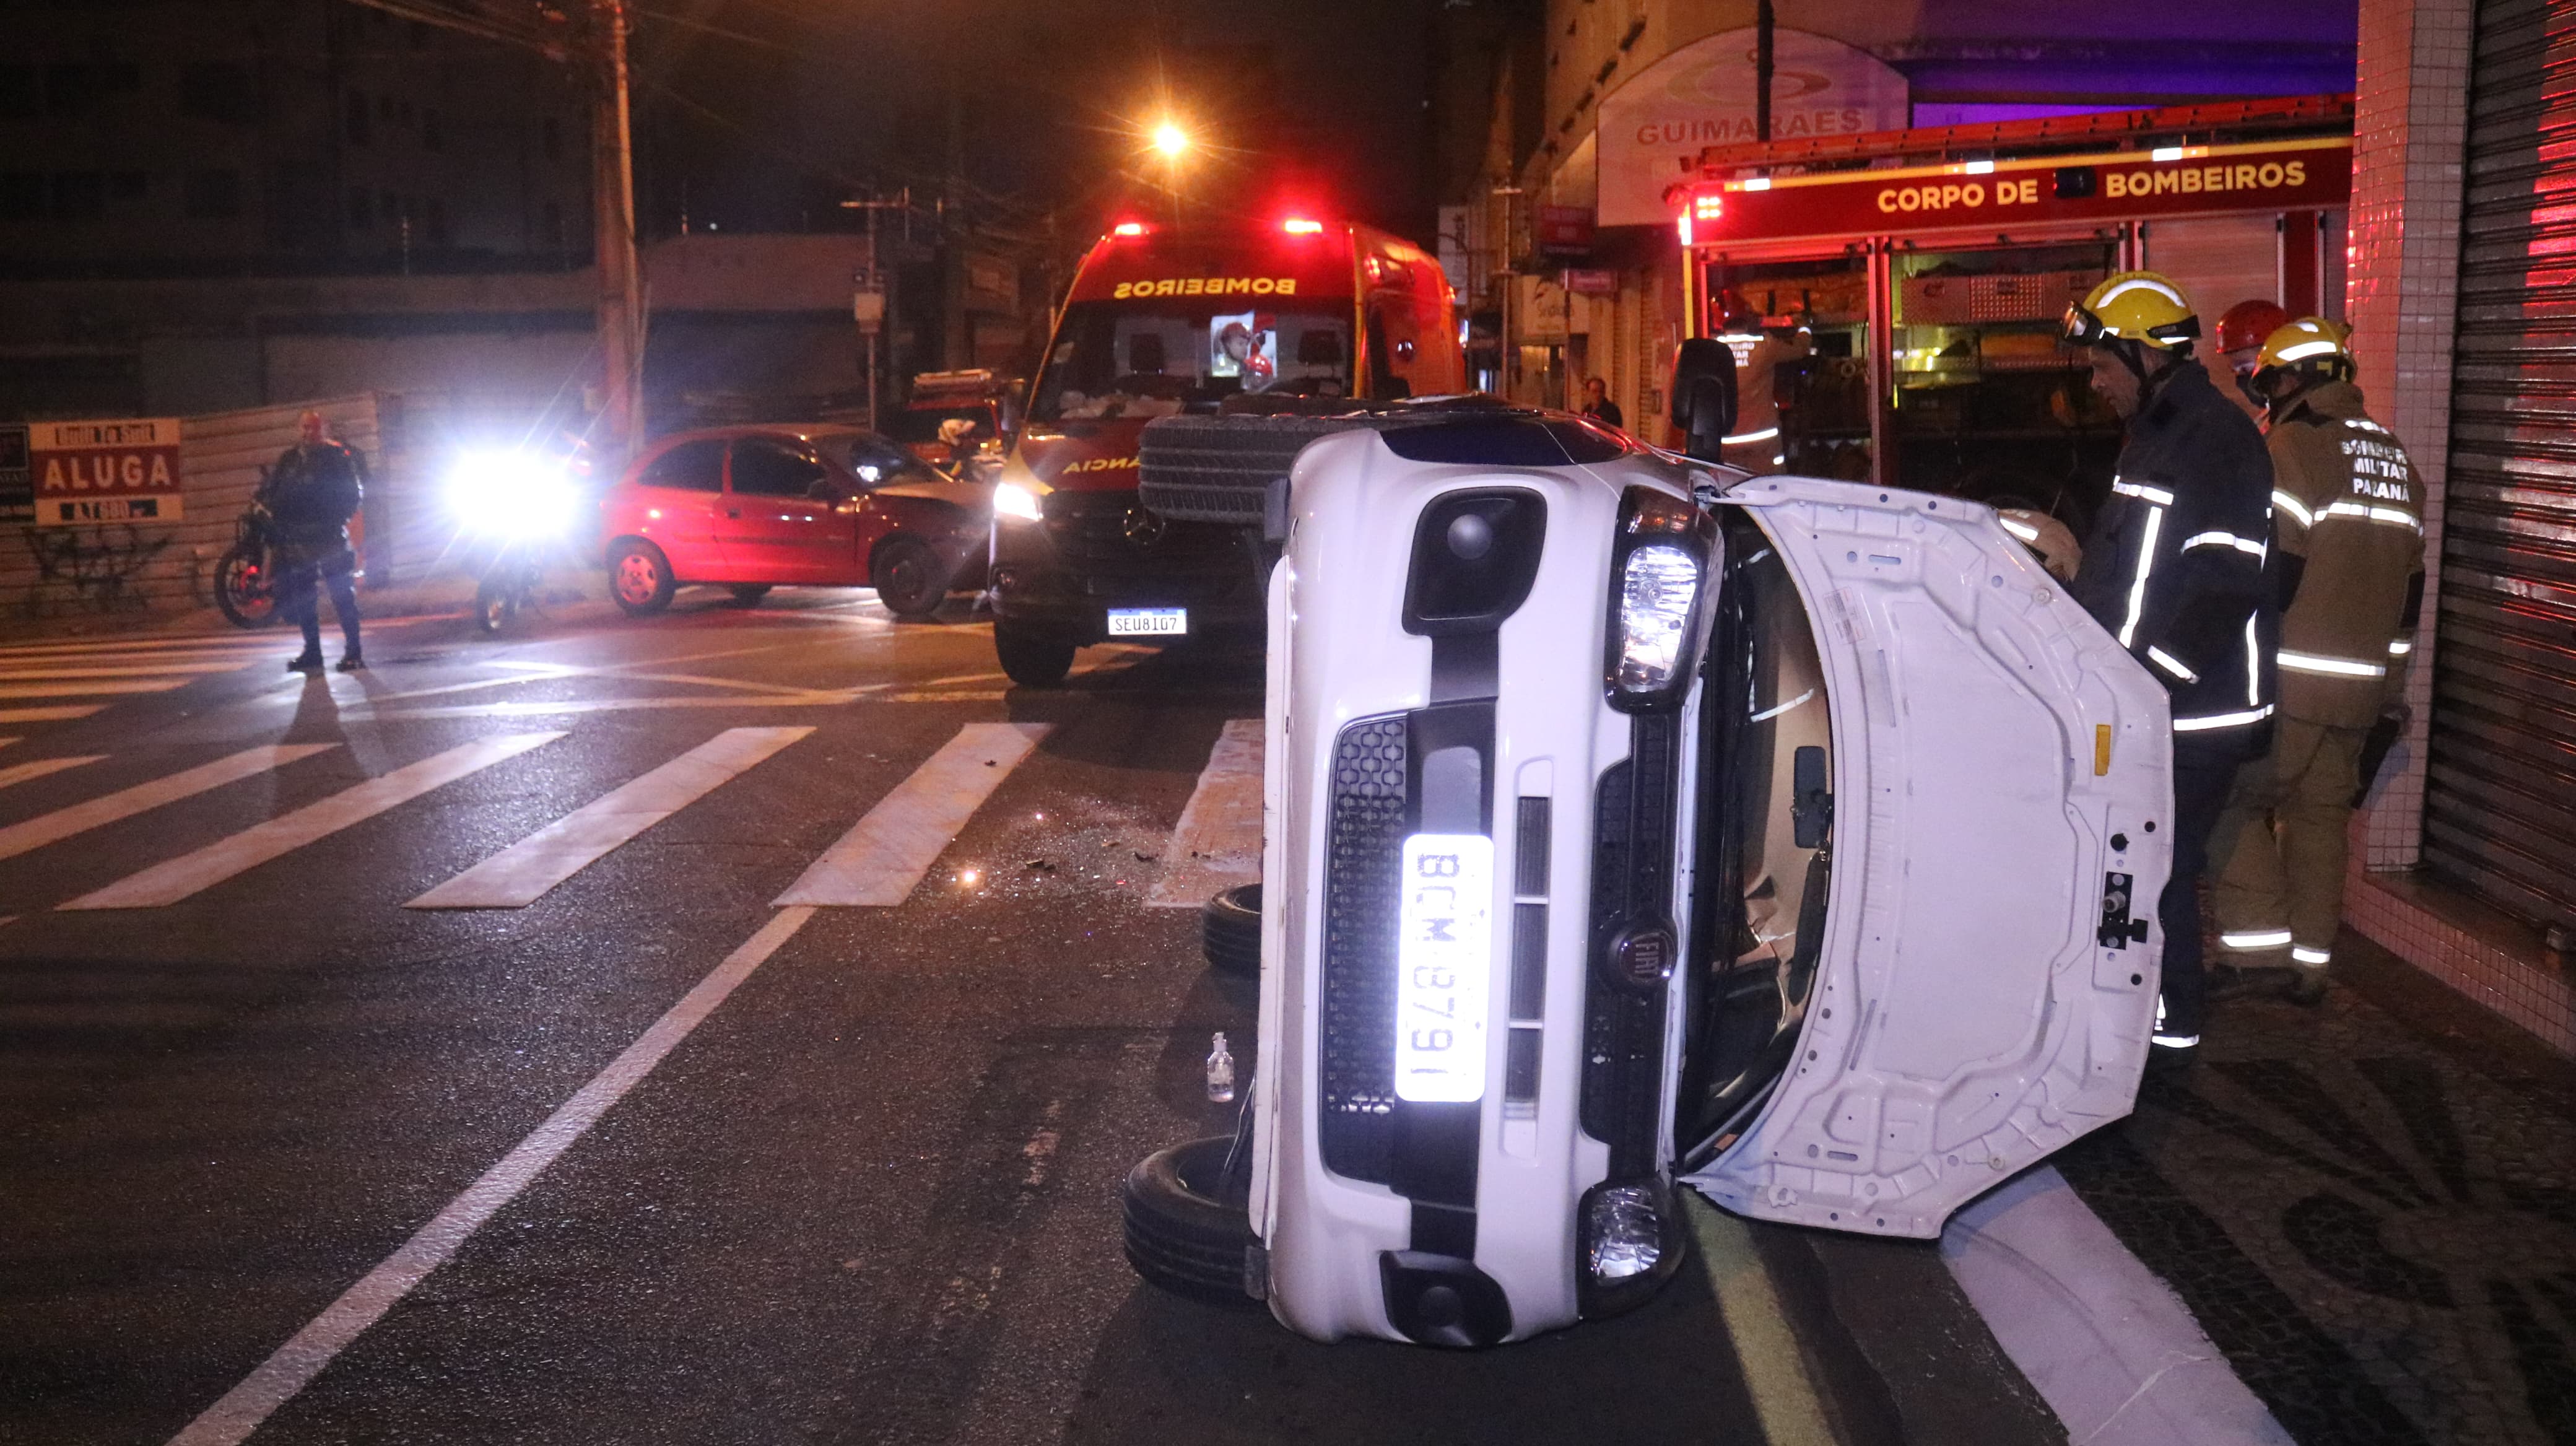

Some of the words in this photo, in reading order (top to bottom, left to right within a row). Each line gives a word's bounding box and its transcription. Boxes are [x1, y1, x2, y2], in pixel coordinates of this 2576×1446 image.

[1878, 183, 1985, 213] CORPO
[1996, 178, 2039, 205] DE
[2105, 160, 2307, 198] BOMBEIROS
[43, 454, 172, 490] ALUGA
[2353, 457, 2408, 482] MILITAR
[2352, 477, 2410, 503] PARANÁ
[1634, 942, 1660, 975] FIAT
